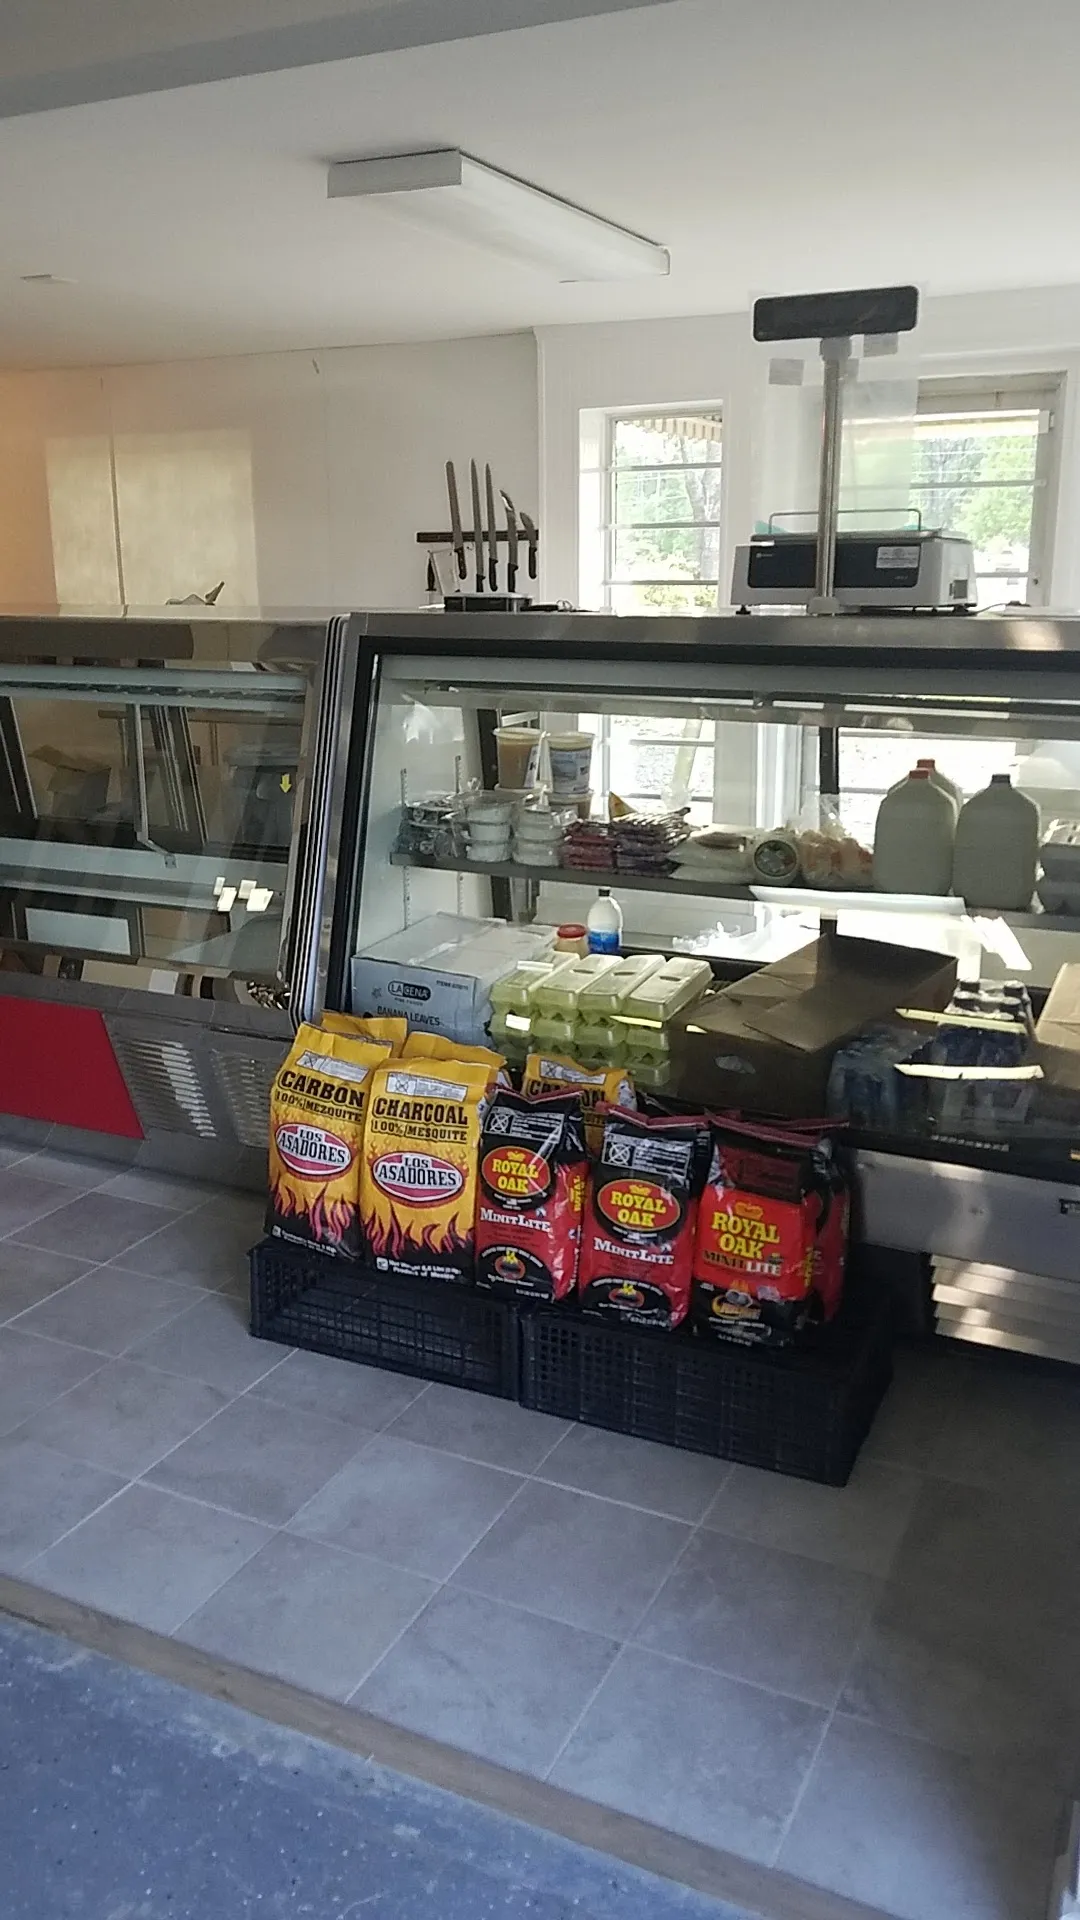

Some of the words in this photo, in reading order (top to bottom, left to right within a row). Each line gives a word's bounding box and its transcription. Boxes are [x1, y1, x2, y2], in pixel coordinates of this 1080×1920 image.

[410, 1010, 440, 1026] LEAVES
[280, 1070, 365, 1108] CARBON
[276, 1090, 303, 1107] 100%
[305, 1100, 361, 1122] MEZQUITE
[375, 1098, 468, 1126] CHARCOAL
[300, 1129, 323, 1142] LOS
[374, 1120, 404, 1134] 100%
[407, 1125, 467, 1141] MESQUITE
[279, 1132, 346, 1163] ASADORES
[404, 1157, 429, 1168] LOS
[492, 1158, 539, 1178] ROYAL
[378, 1164, 457, 1186] ASADORES
[497, 1175, 529, 1194] OAK
[610, 1190, 667, 1214] ROYAL
[617, 1208, 655, 1227] OAK
[711, 1211, 780, 1243] ROYAL
[719, 1233, 765, 1260] OAK
